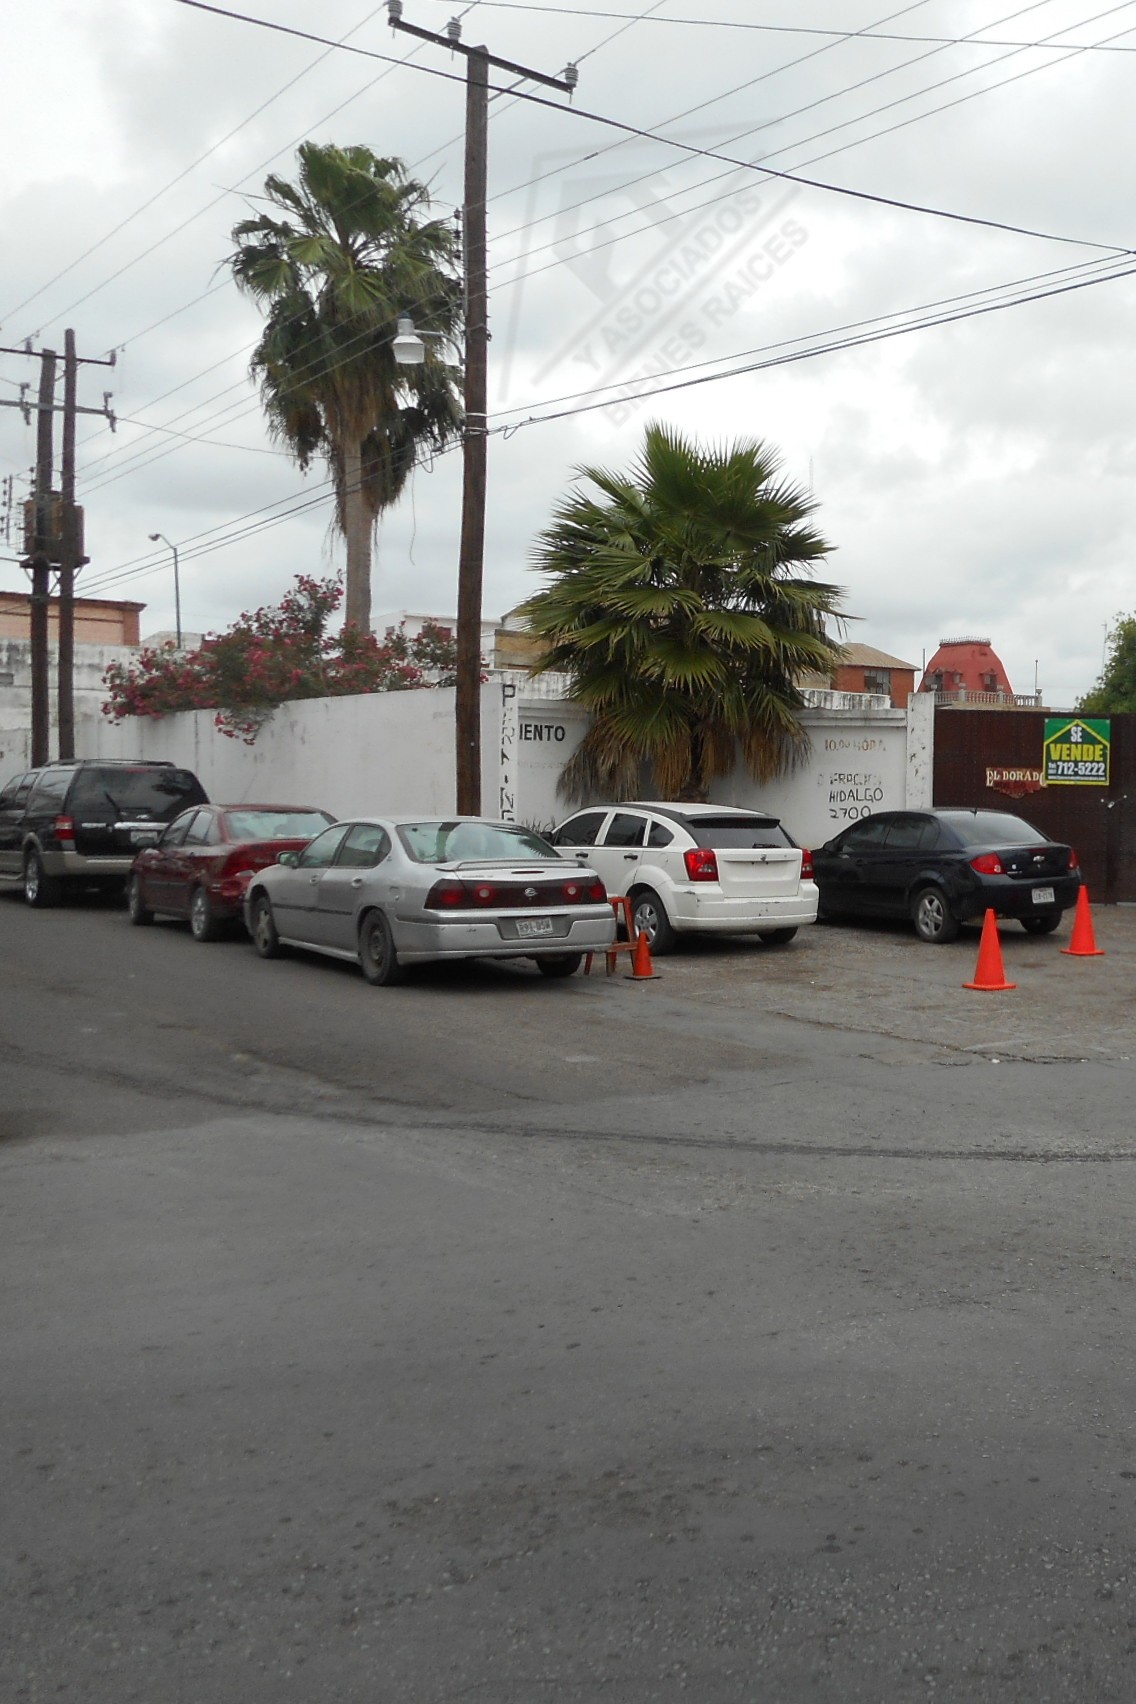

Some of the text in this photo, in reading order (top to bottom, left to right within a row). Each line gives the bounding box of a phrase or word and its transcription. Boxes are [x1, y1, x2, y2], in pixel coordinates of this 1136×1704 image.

[1070, 726, 1083, 742] SE
[1050, 744, 1104, 761] VENDE
[1057, 761, 1105, 776] 712-5222
[986, 771, 1048, 788] EL DORADO
[829, 787, 884, 803] HIDALGO
[829, 805, 872, 819] 2700
